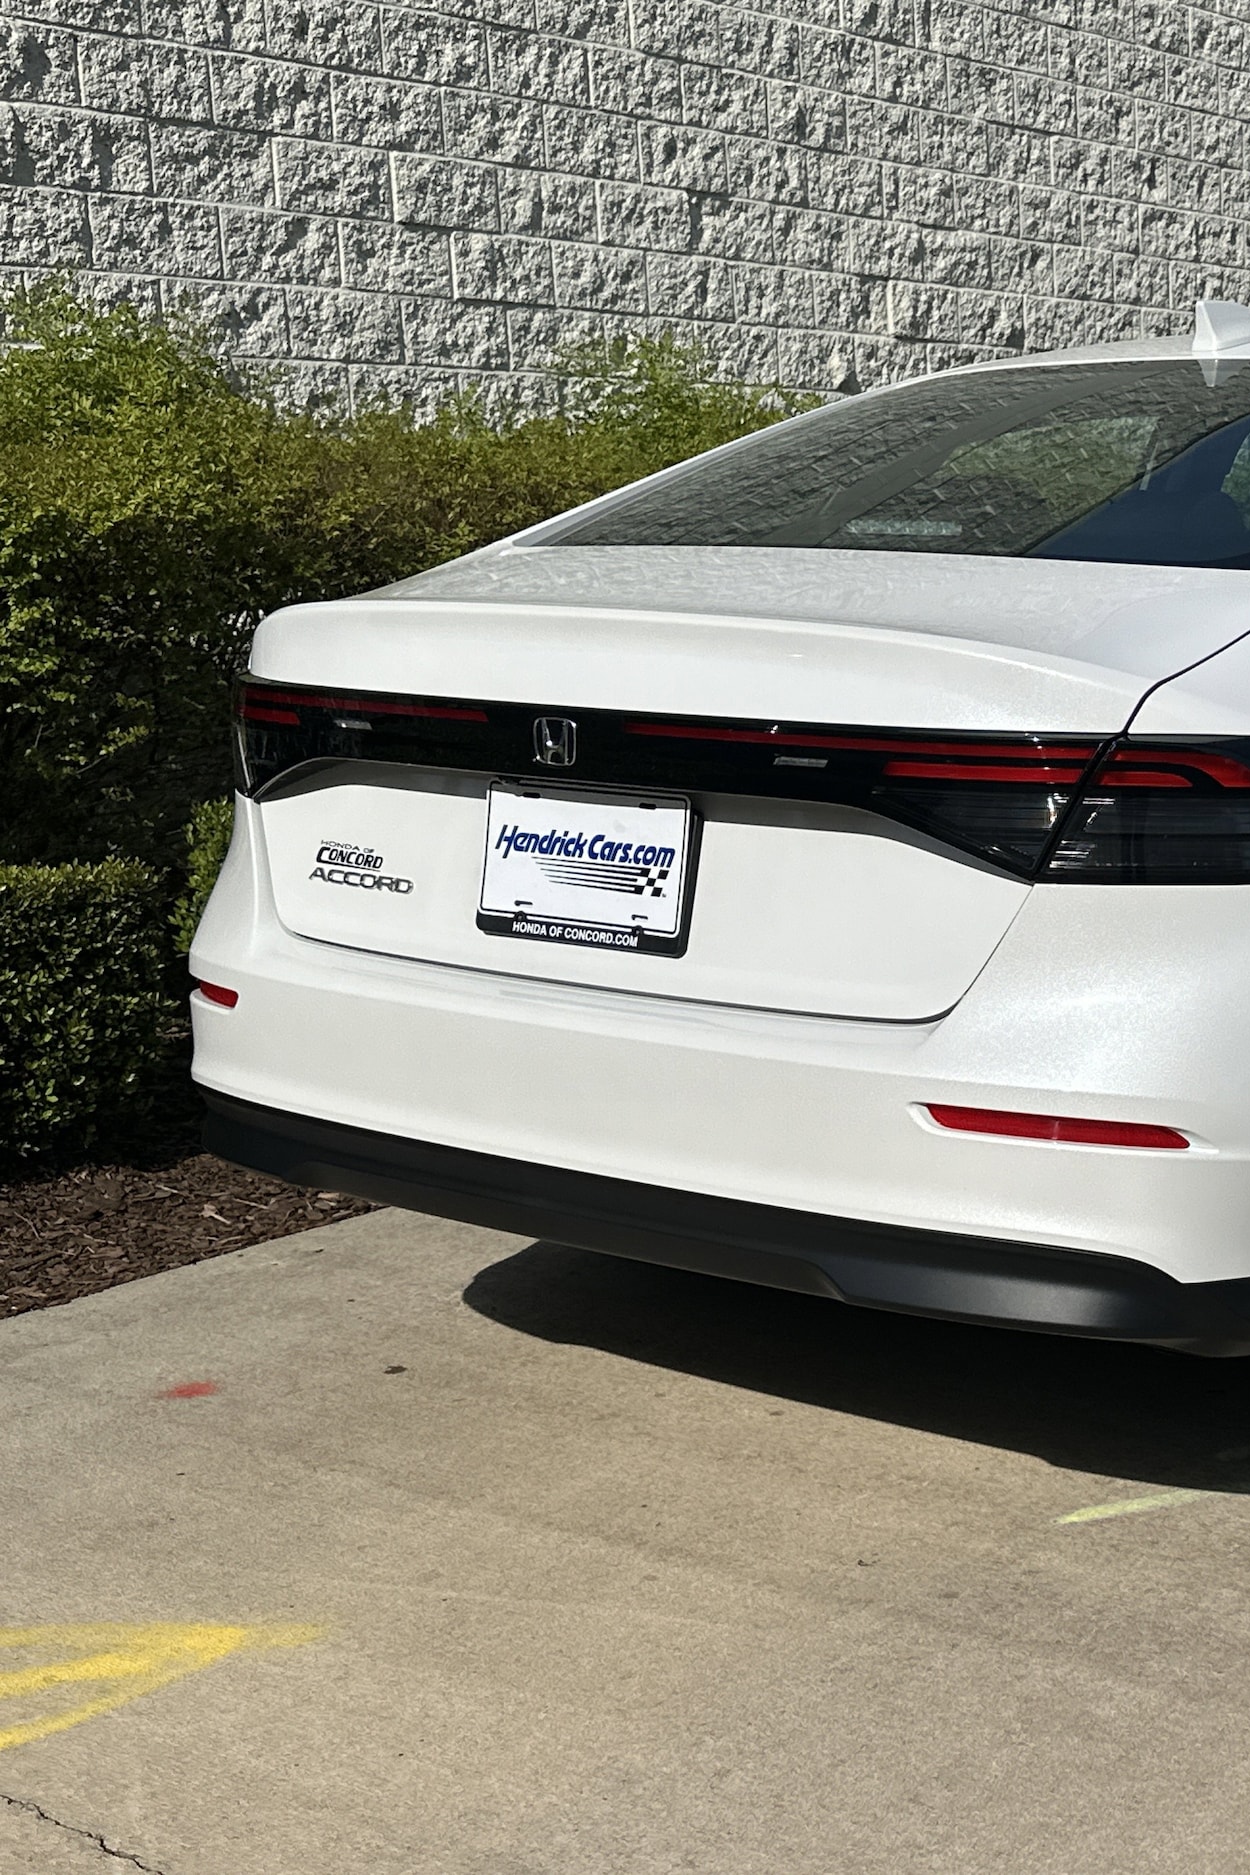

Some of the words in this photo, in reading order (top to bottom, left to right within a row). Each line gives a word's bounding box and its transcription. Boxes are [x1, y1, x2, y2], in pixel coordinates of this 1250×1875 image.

[316, 846, 383, 869] CONCORD
[320, 840, 360, 851] HONDA
[308, 867, 414, 894] ACCORD
[512, 920, 547, 936] HONDA
[548, 925, 564, 938] OF
[564, 927, 639, 947] CONCORD.COM
